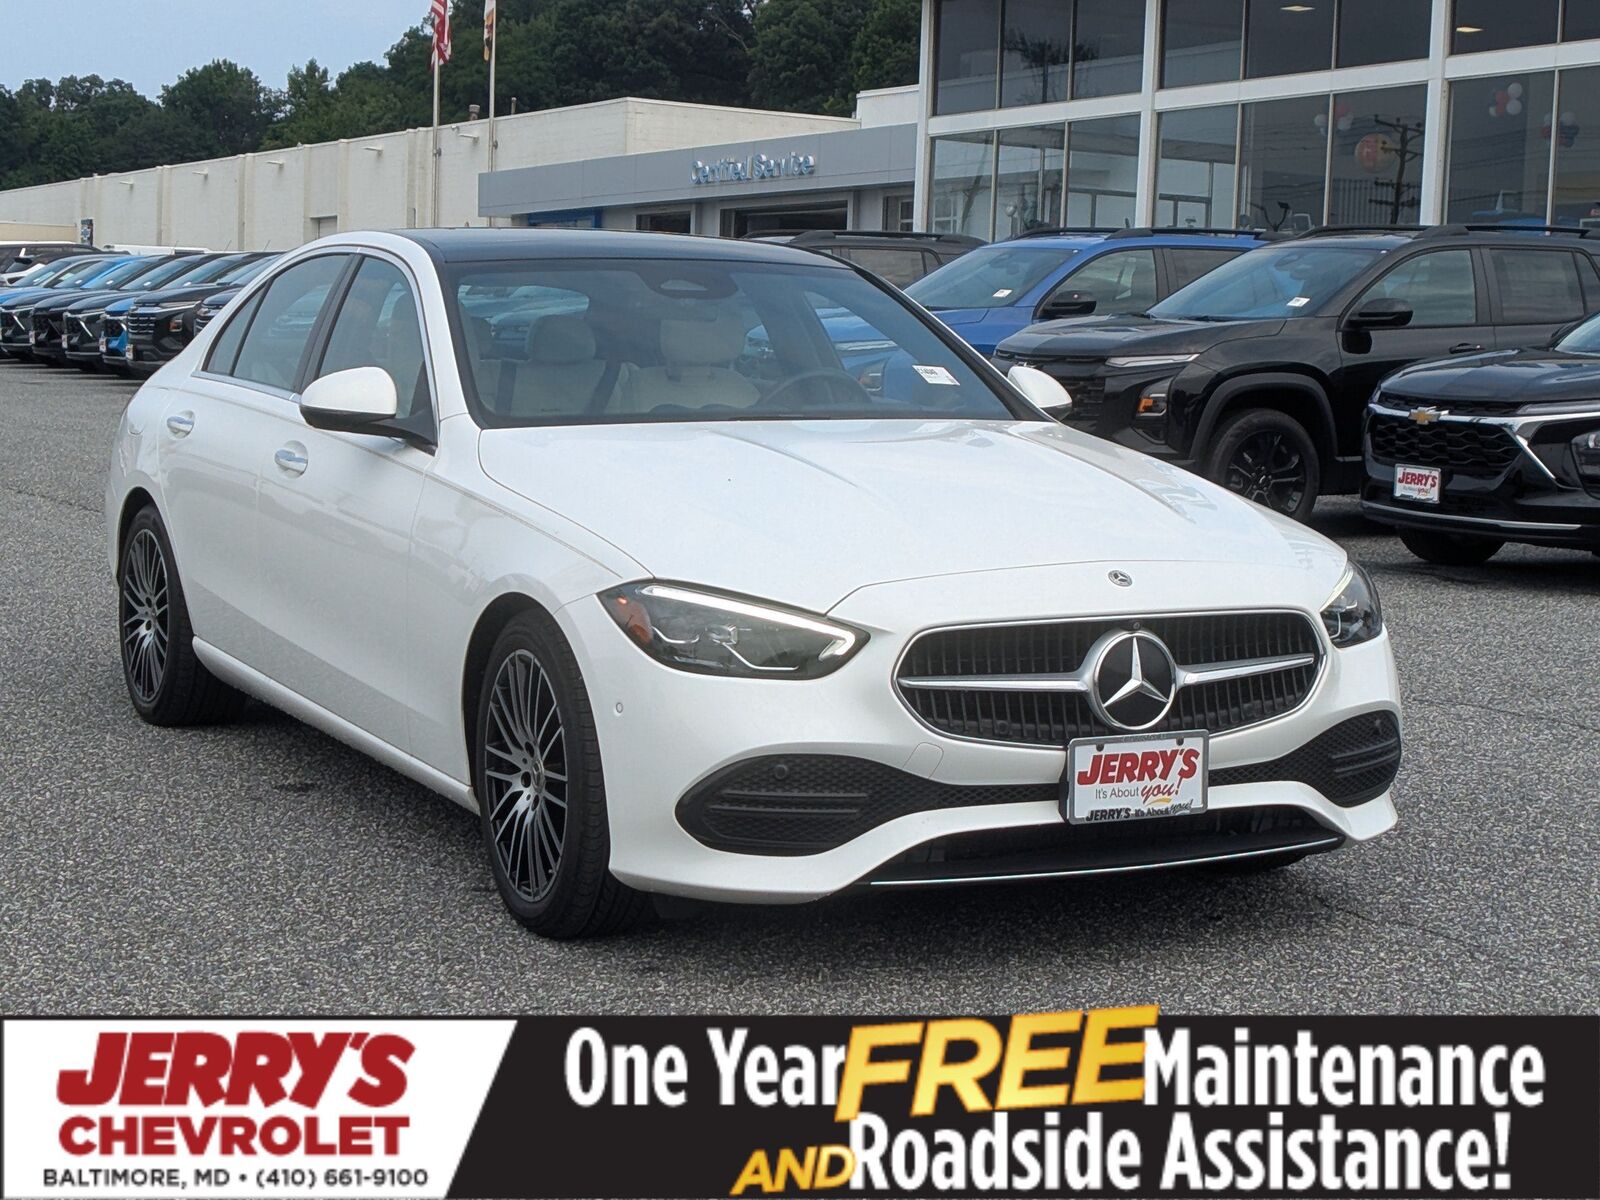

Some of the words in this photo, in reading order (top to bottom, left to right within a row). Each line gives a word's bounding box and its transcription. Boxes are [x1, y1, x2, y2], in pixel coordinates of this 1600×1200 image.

[690, 157, 750, 184] Certified
[753, 152, 815, 179] Service
[1398, 472, 1438, 488] JERRY'S
[1077, 748, 1200, 785] JERRY'S
[1095, 786, 1107, 799] It's
[1109, 786, 1139, 798] About
[1141, 777, 1183, 805] you!
[1086, 807, 1131, 821] JERRY'S
[1145, 806, 1169, 816] About
